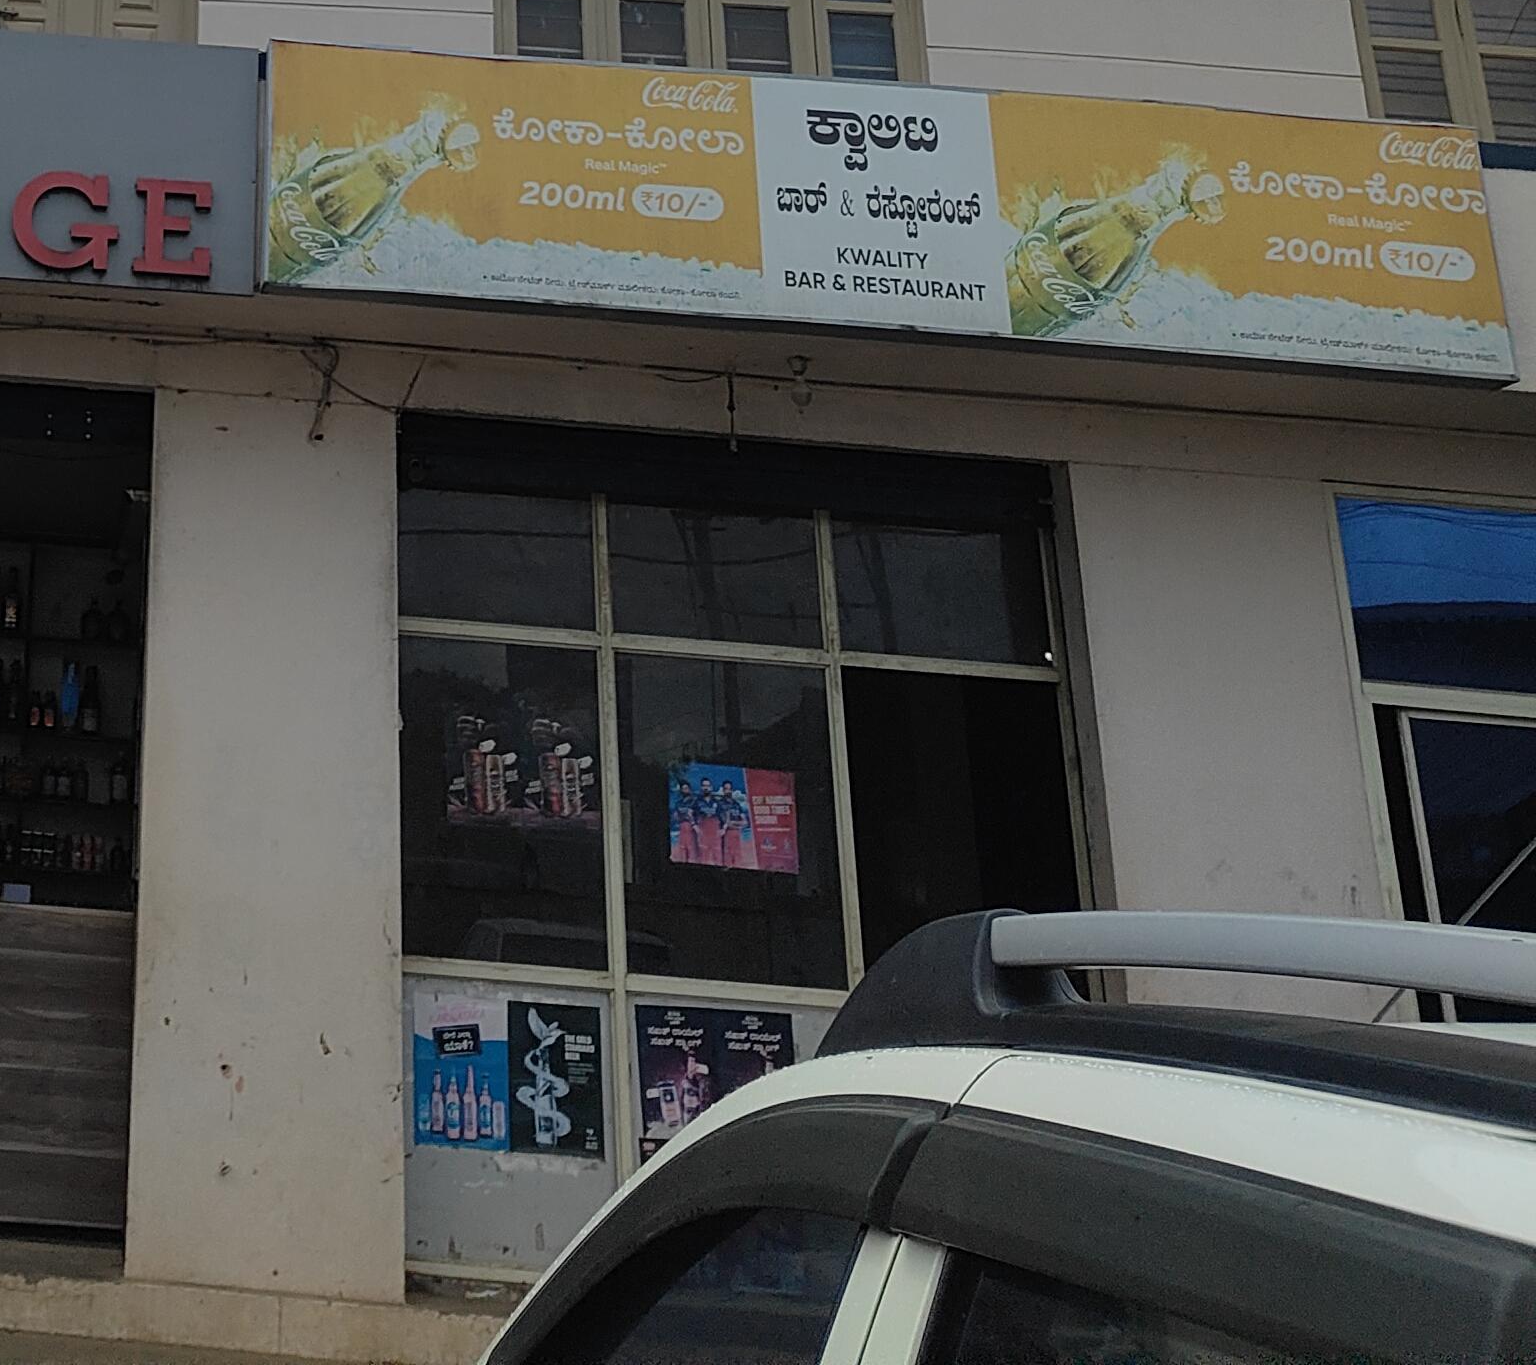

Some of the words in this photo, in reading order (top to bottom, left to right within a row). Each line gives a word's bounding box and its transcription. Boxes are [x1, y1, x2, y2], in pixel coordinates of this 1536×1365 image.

[491, 107, 746, 156] ಕೋಕಾ-ಕೋಲಾ
[806, 108, 939, 171] ಕ್ವಾಲಿಟಿ
[584, 158, 615, 171] Real
[518, 180, 626, 212] 200ml
[776, 182, 828, 214] ಬಾರ್
[840, 189, 856, 217] &
[1327, 212, 1359, 227] Real
[836, 247, 929, 270] KWALITY
[1265, 236, 1375, 269] 200ml
[784, 270, 826, 291] BAR
[832, 274, 847, 291] &
[852, 276, 987, 302] RESTAURANT
